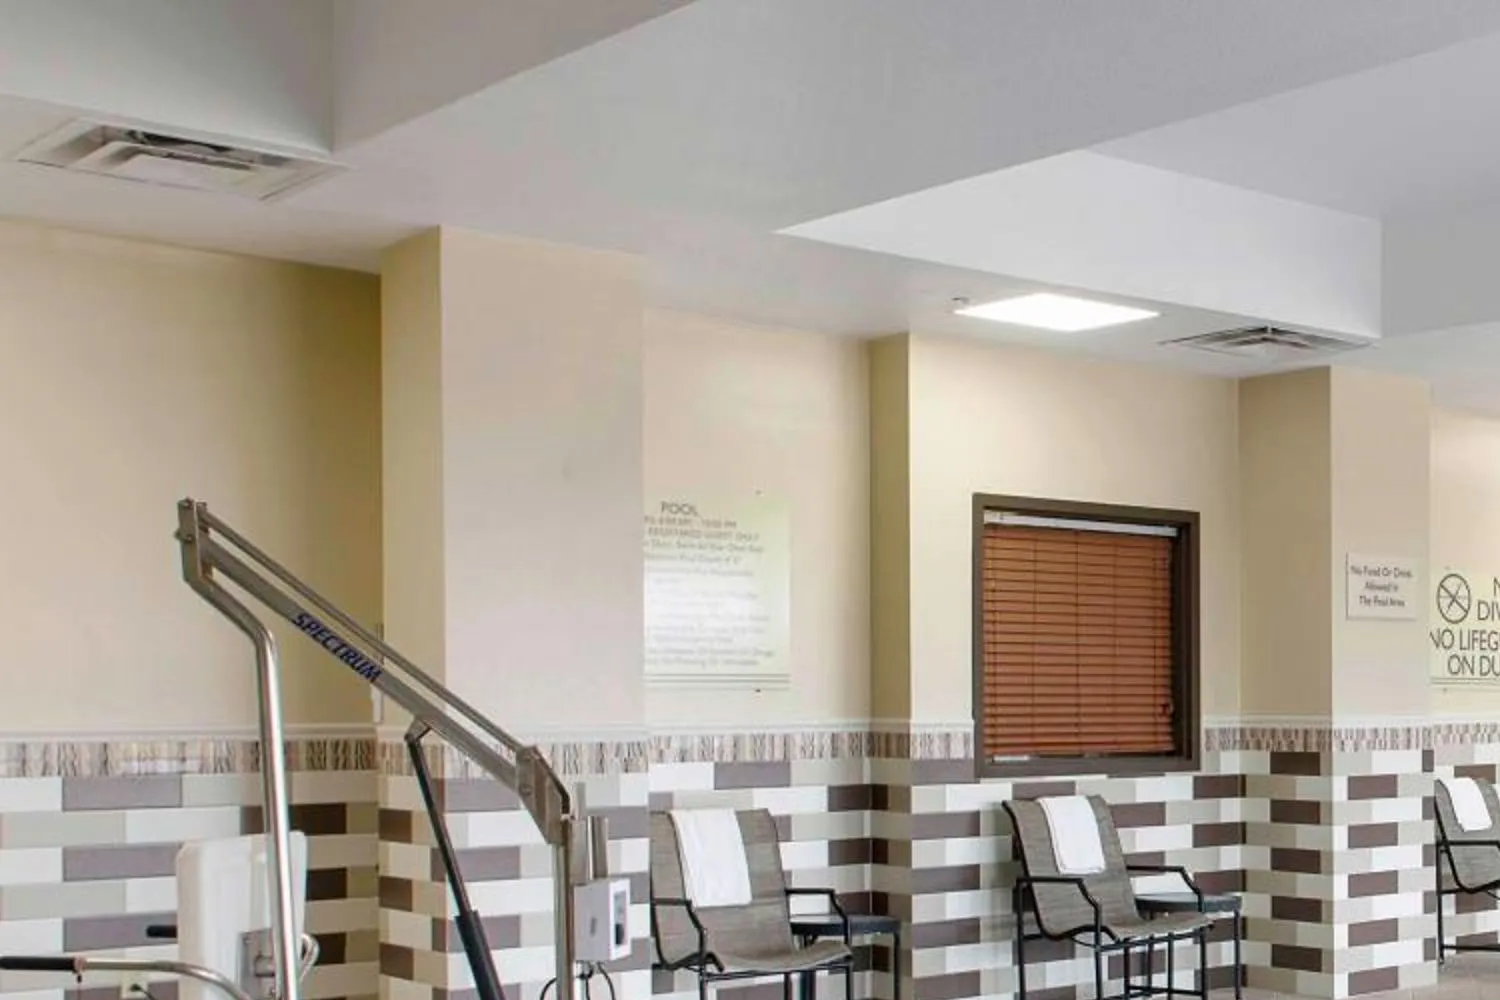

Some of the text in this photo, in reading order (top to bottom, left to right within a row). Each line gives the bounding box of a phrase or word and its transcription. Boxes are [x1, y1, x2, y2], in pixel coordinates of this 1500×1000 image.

[660, 501, 698, 517] POOL
[295, 612, 382, 683] SPECTRUM
[1429, 628, 1455, 650] NO
[1448, 654, 1475, 676] ON
